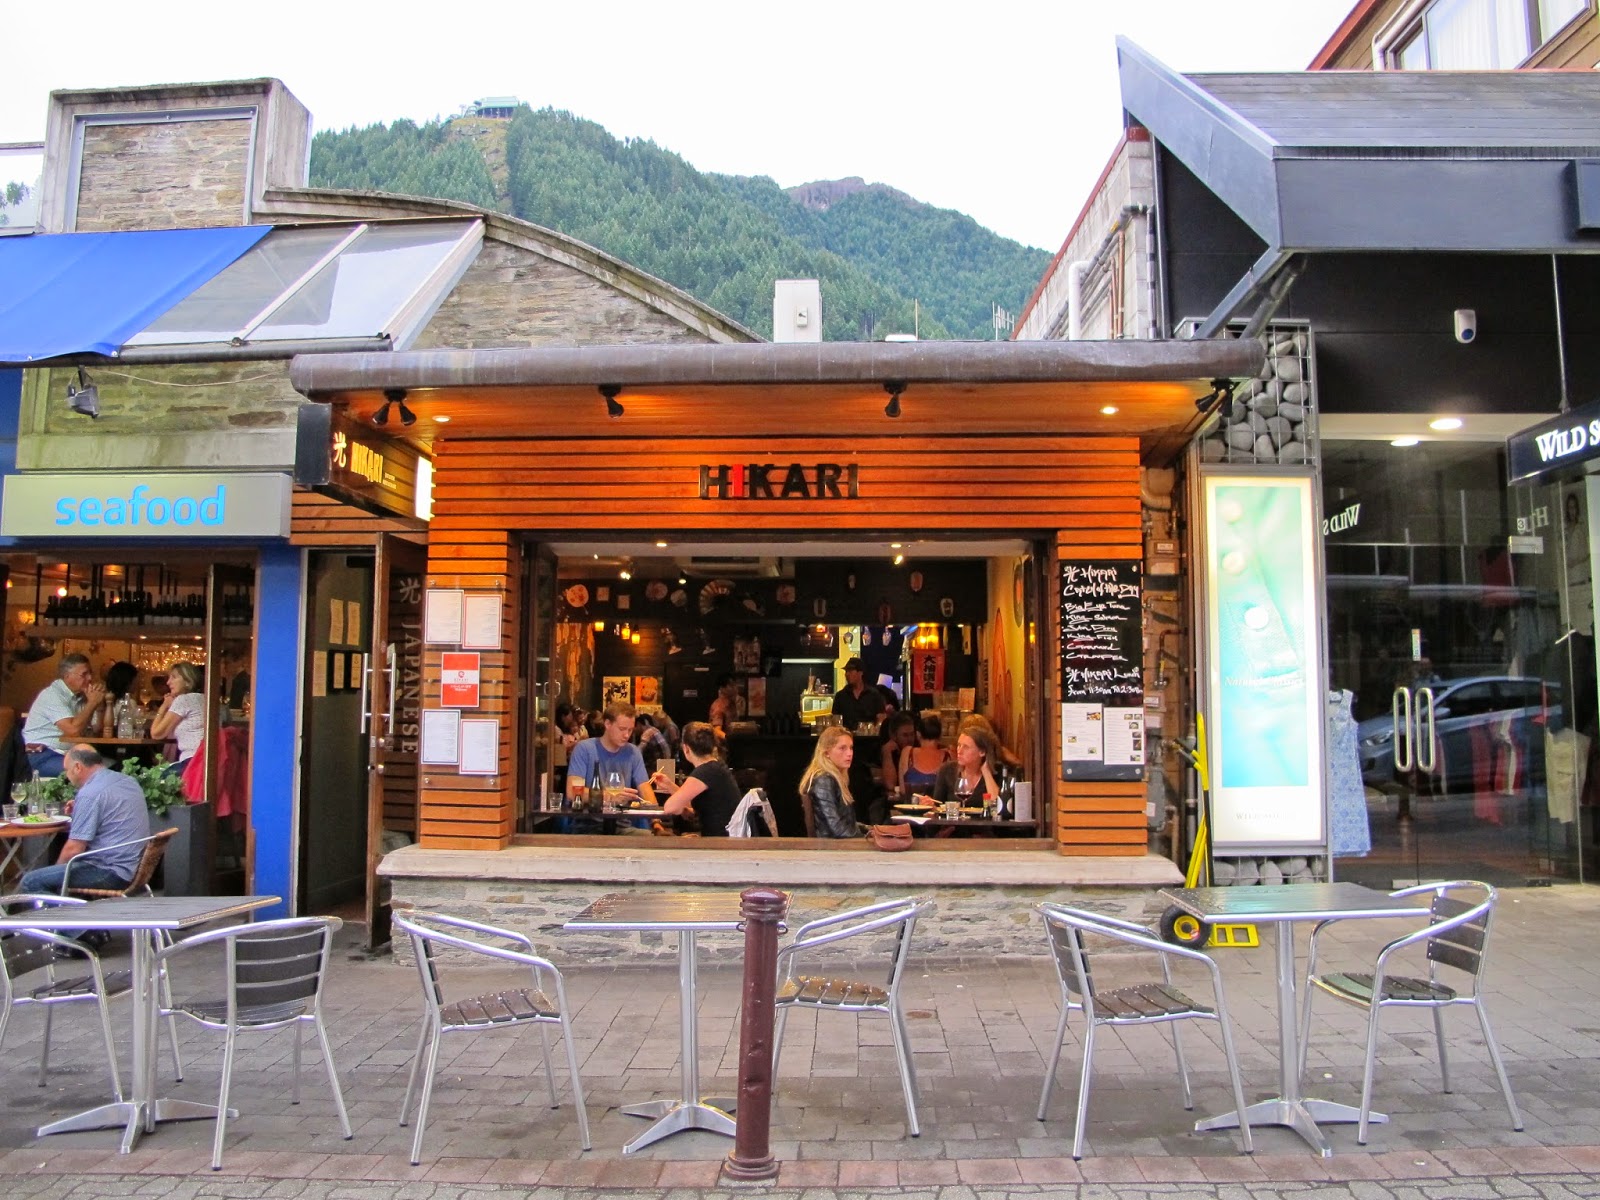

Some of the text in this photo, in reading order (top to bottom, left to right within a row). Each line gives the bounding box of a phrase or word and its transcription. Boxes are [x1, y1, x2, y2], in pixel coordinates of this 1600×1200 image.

[333, 431, 347, 468] 光
[351, 441, 383, 483] HIKARI
[1535, 426, 1587, 462] WILD
[700, 464, 858, 500] HIKARI
[55, 484, 226, 526] seafood
[400, 577, 422, 755] 光 JAPANESE
